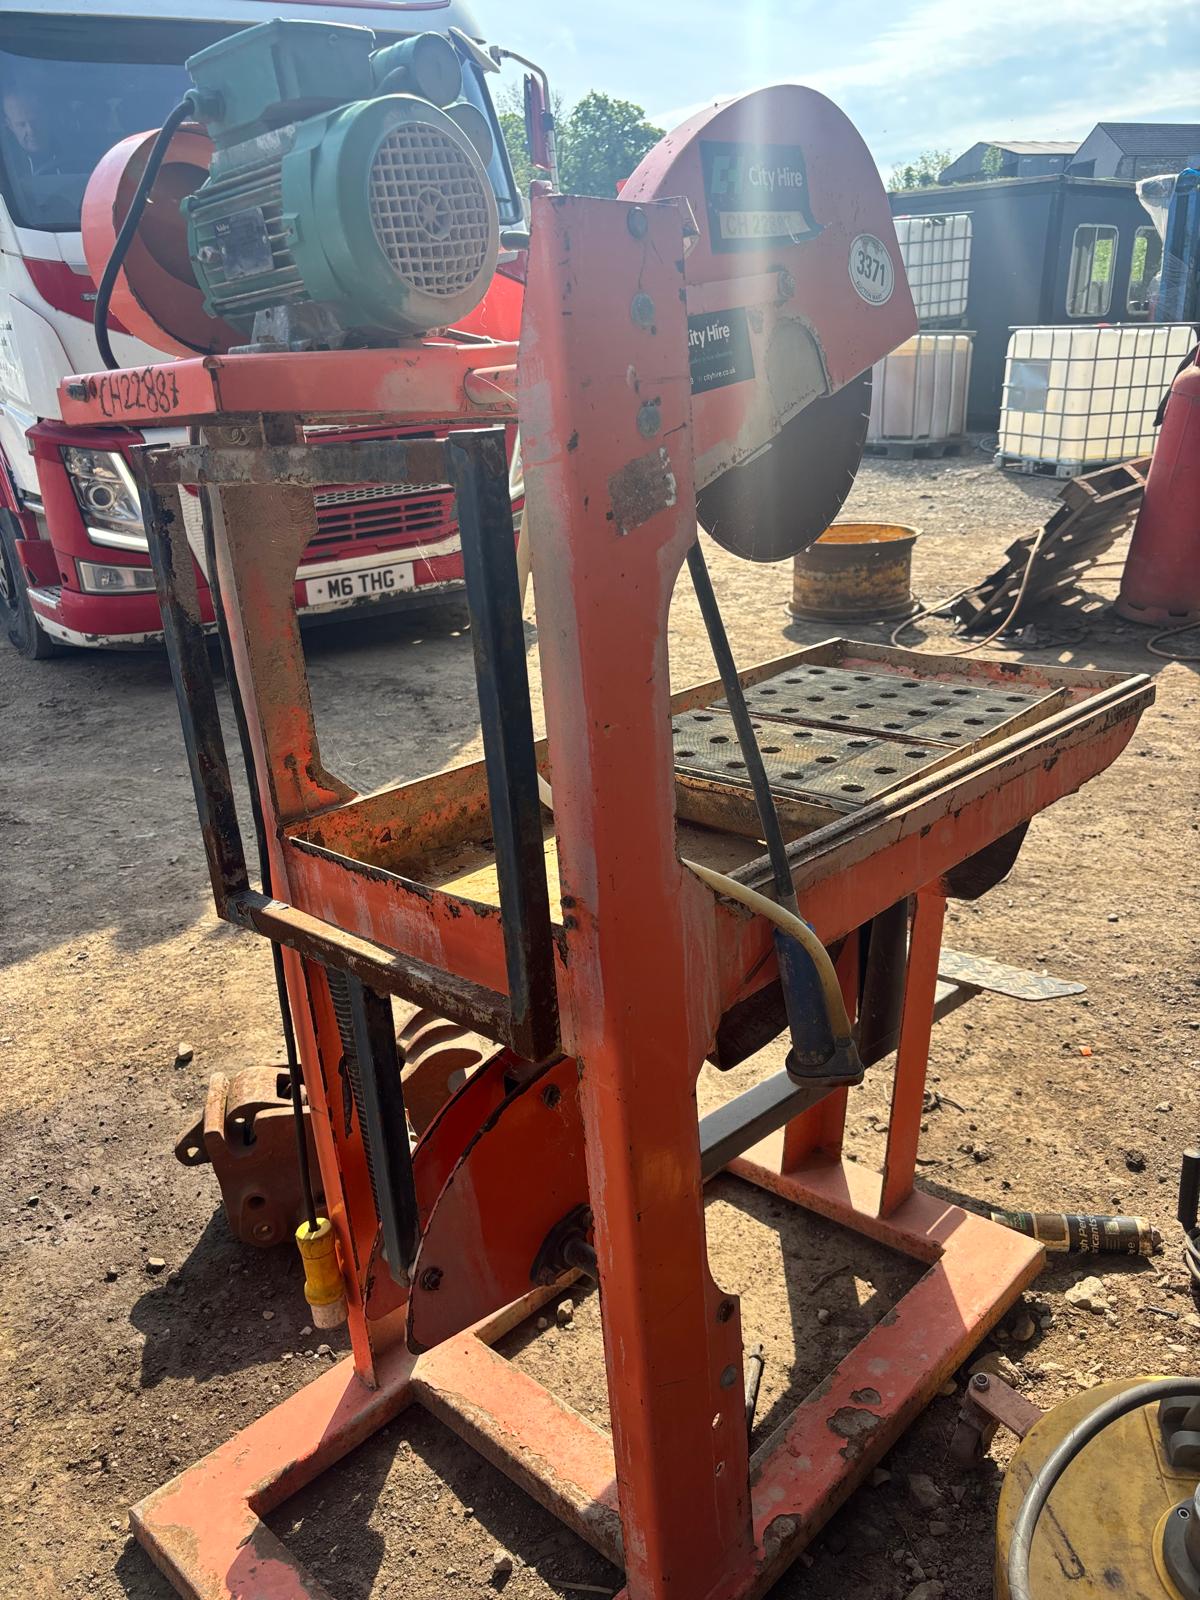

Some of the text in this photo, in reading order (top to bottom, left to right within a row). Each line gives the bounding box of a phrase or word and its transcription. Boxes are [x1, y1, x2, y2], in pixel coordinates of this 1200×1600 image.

[748, 166, 803, 192] City Hire
[857, 250, 885, 286] 3371
[688, 323, 730, 348] ity Hire
[99, 366, 179, 417] CH22887
[328, 570, 395, 598] M6 THG
